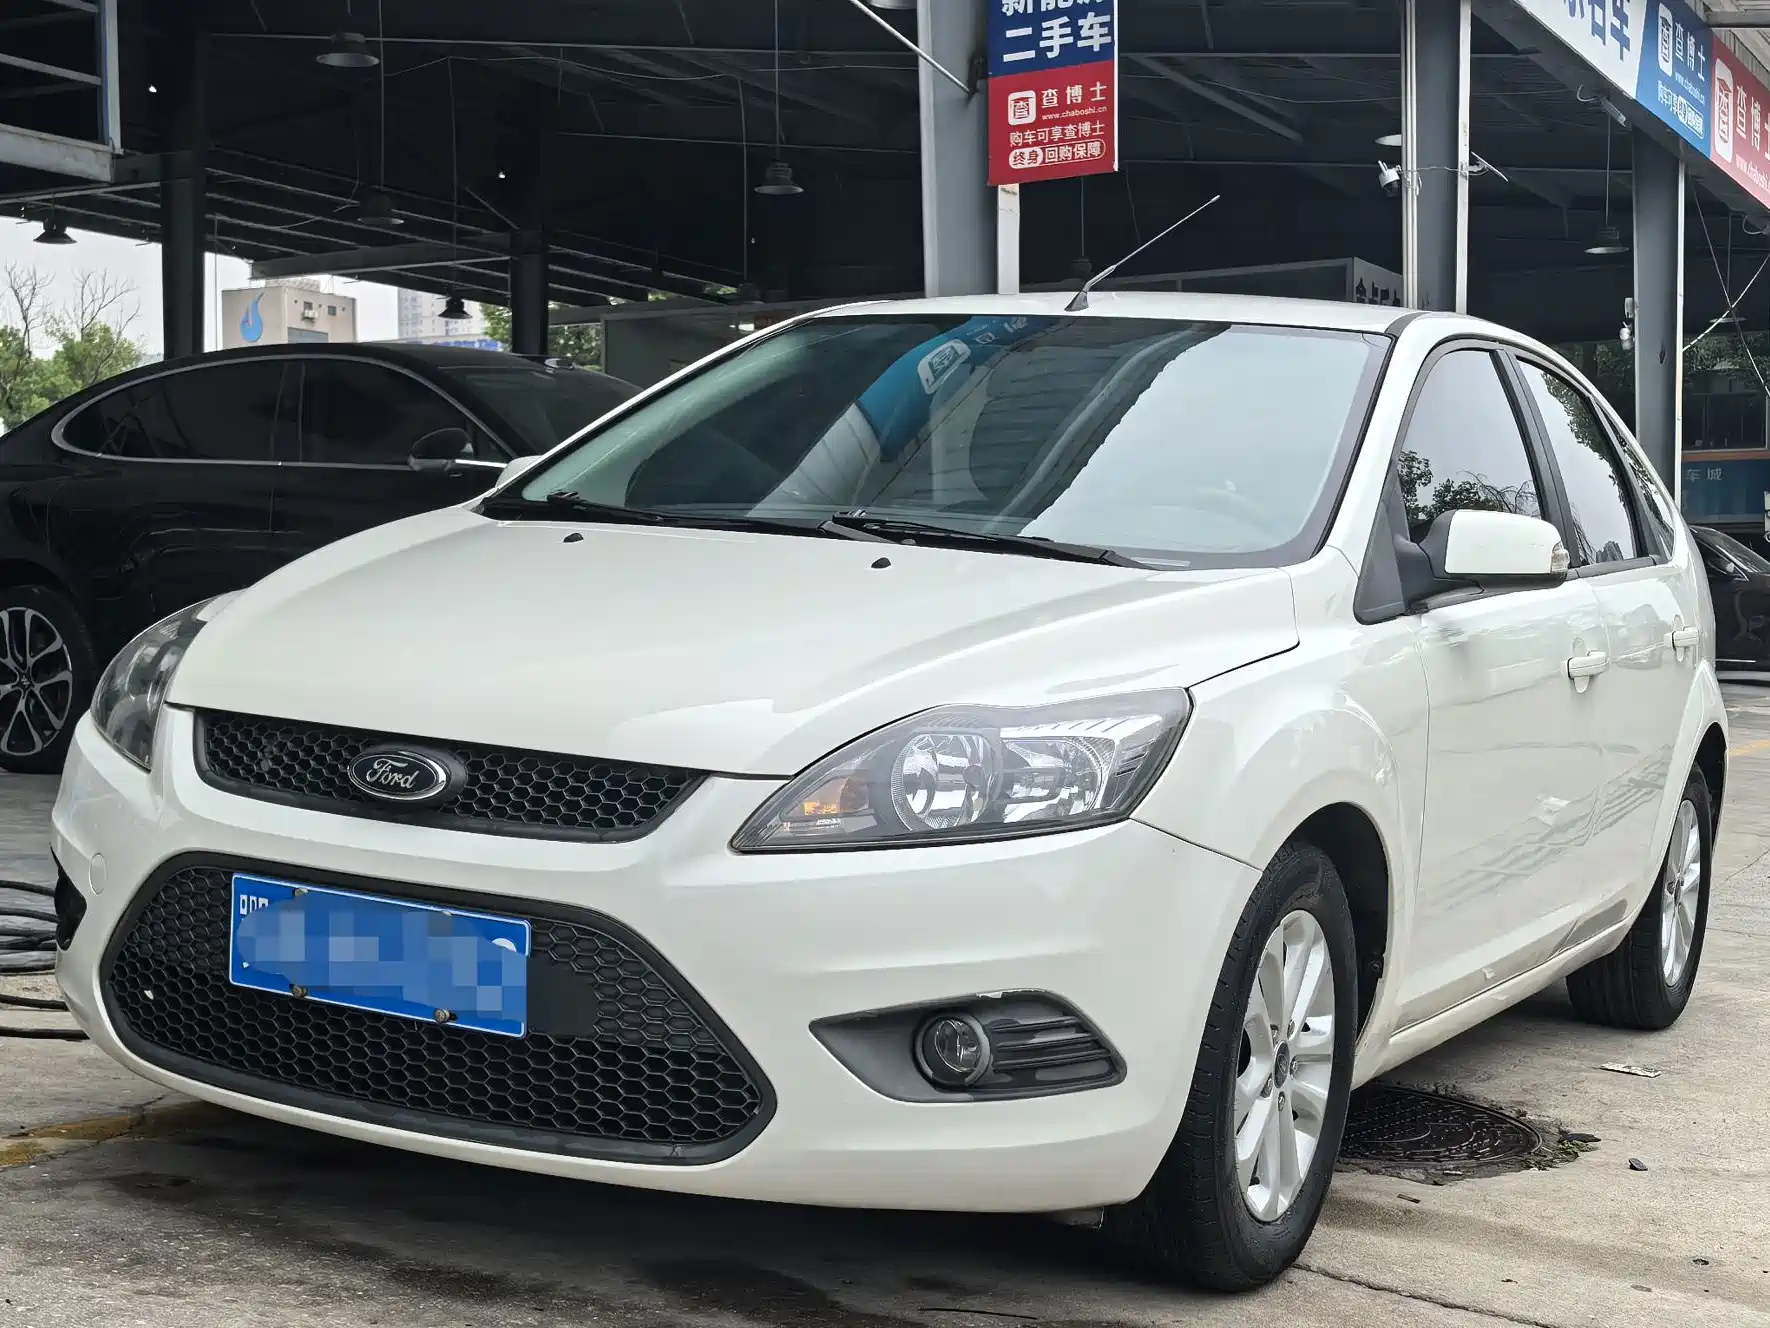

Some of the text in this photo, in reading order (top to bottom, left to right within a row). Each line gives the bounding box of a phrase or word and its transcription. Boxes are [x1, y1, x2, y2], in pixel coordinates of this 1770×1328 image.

[1003, 12, 1112, 62] 二手车
[1675, 22, 1705, 82] 查博士
[1041, 81, 1107, 108] 查博士
[1042, 106, 1107, 120] www.chaboshi.cn
[1010, 120, 1105, 147] 购车可享查博士
[366, 758, 419, 789] Ford
